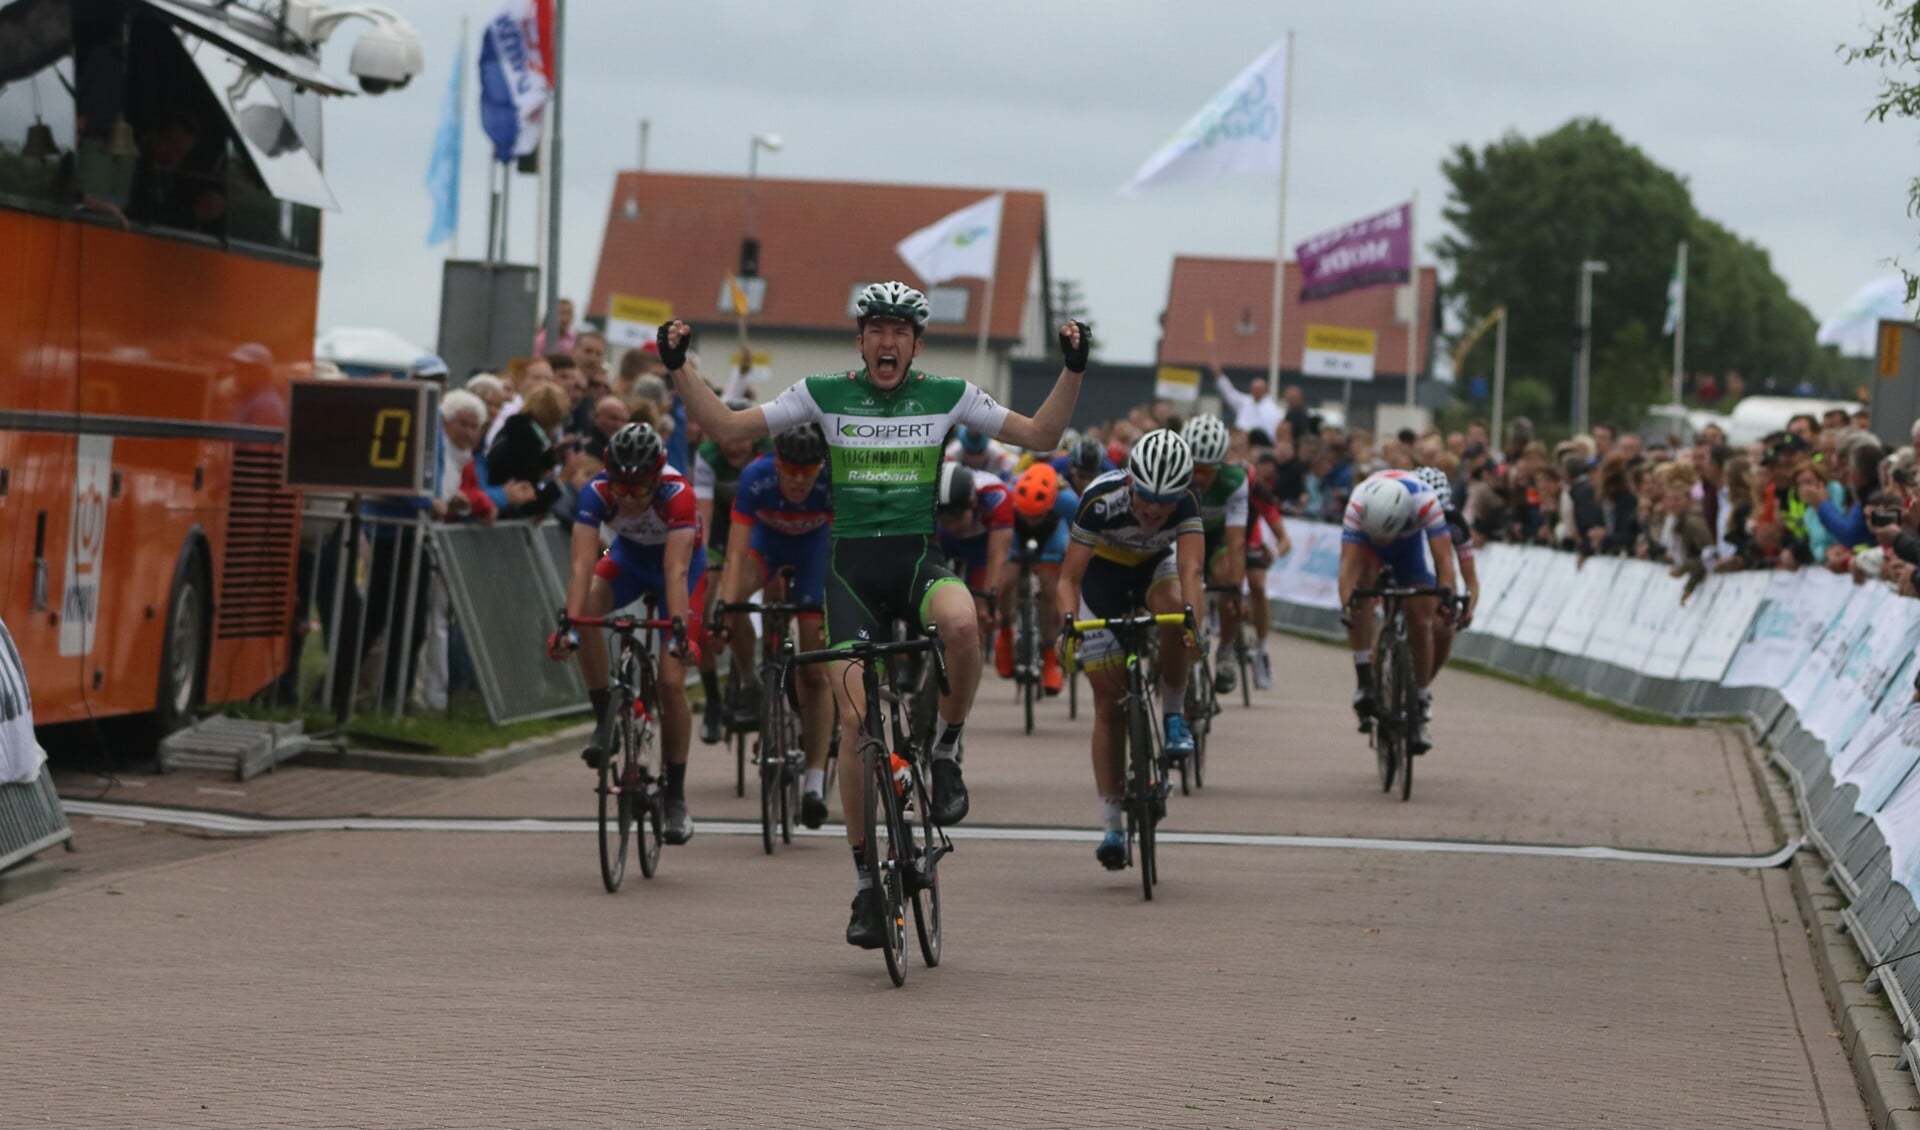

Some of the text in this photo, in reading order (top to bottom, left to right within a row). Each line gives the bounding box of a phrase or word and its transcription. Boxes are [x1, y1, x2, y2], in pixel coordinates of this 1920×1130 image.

[836, 416, 934, 438] KOPPERT
[370, 409, 411, 468] 0
[848, 470, 919, 482] Rabobank
